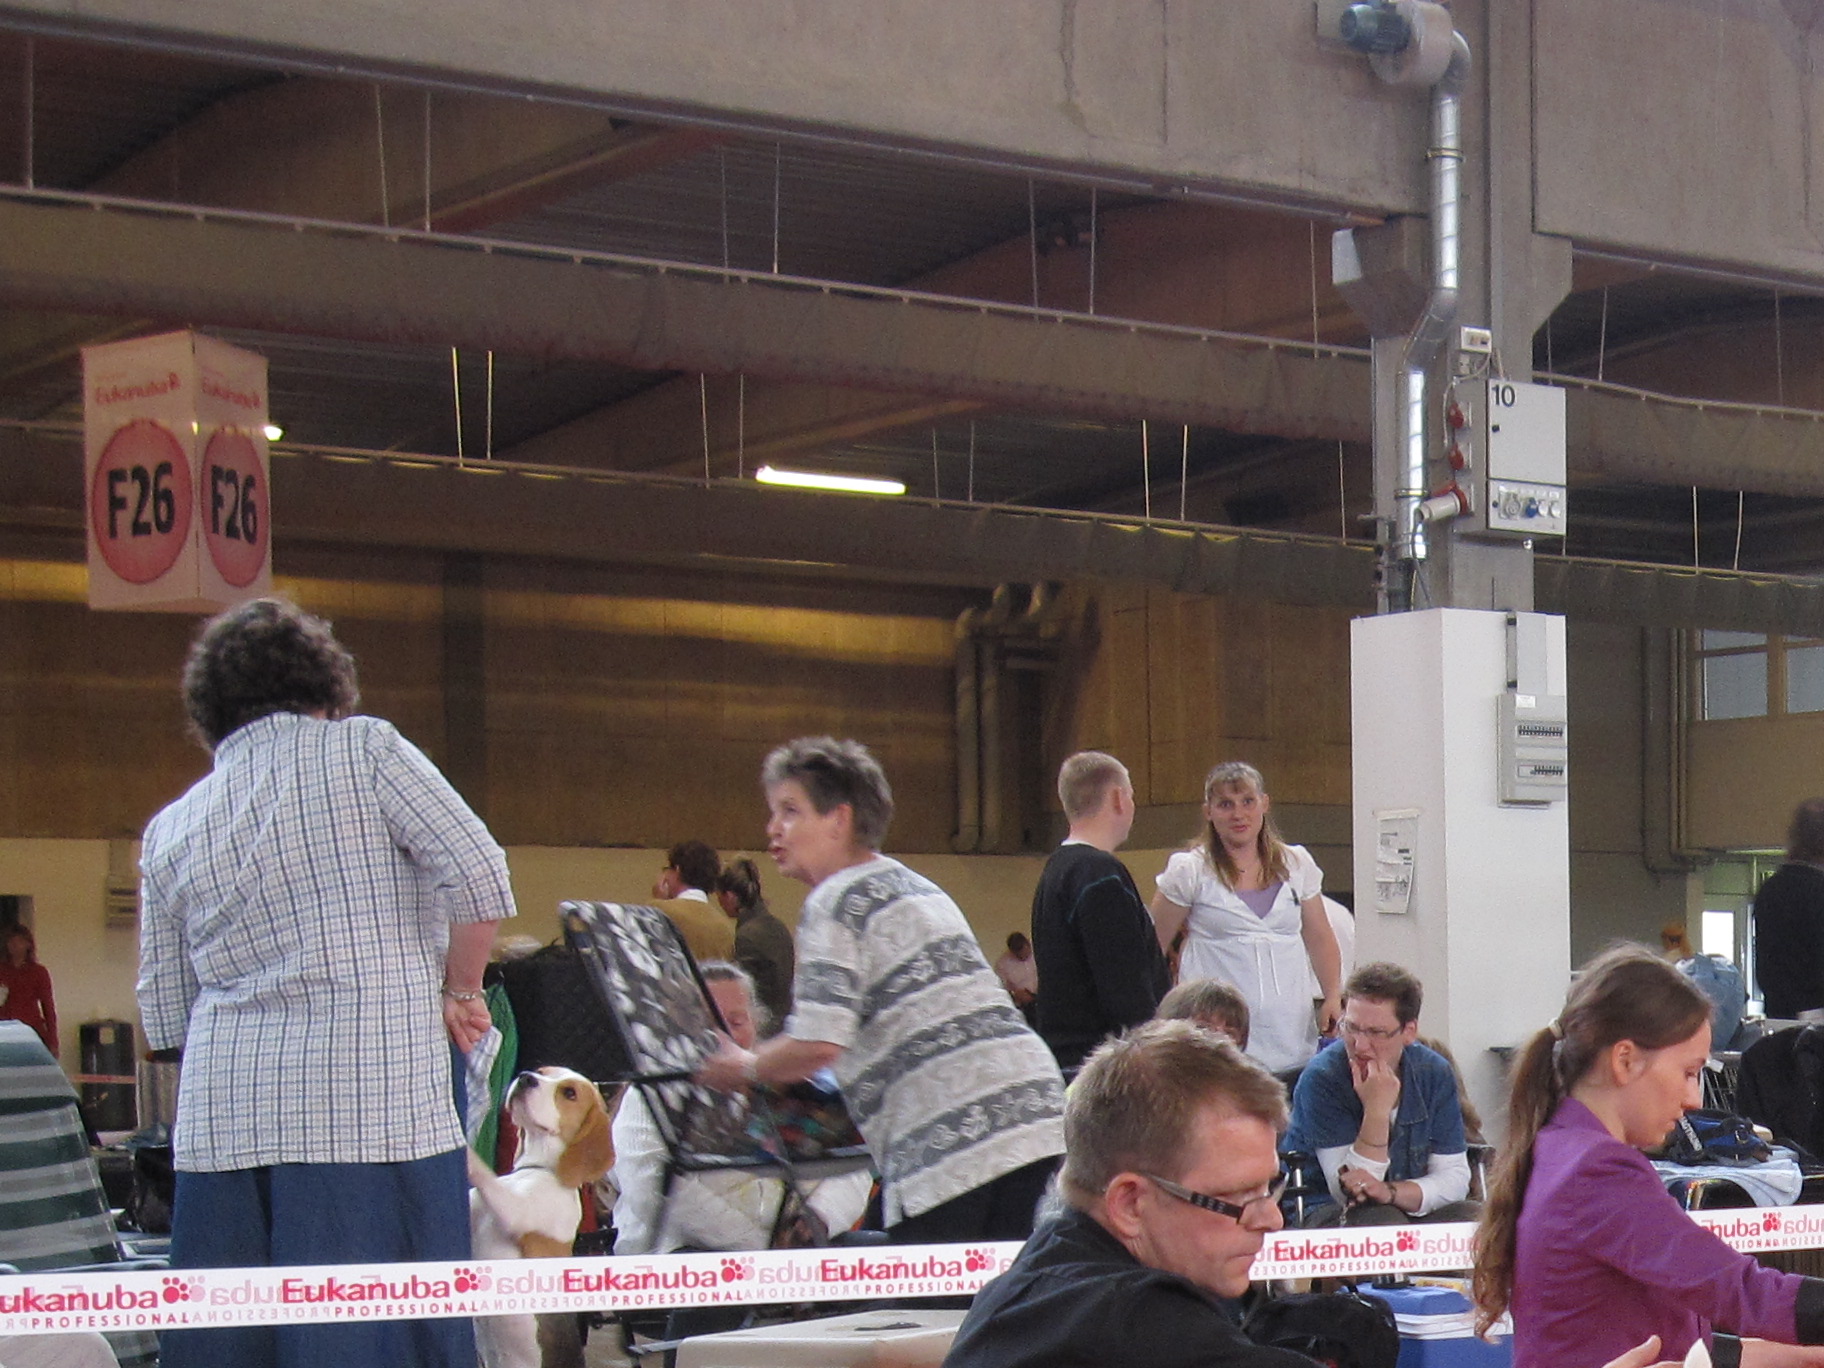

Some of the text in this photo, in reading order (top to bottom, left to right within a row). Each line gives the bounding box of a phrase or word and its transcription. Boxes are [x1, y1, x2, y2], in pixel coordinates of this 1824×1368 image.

[1491, 384, 1516, 408] 10
[107, 461, 175, 539] F26
[210, 463, 258, 545] F26
[1711, 1218, 1760, 1240] nuba
[1274, 1236, 1394, 1262] Eukanuba
[563, 1259, 718, 1295] Eukanuba
[821, 1257, 962, 1283] Eukanuba
[1311, 1260, 1414, 1274] PROFESSIONAL
[281, 1274, 451, 1303] Eukanuba
[611, 1289, 743, 1307] PROFESSIONAL
[865, 1278, 986, 1294] PROFESSIONAL
[32, 1313, 189, 1330] PROFESSIONAL
[335, 1301, 478, 1318] PROFESSIONAL
